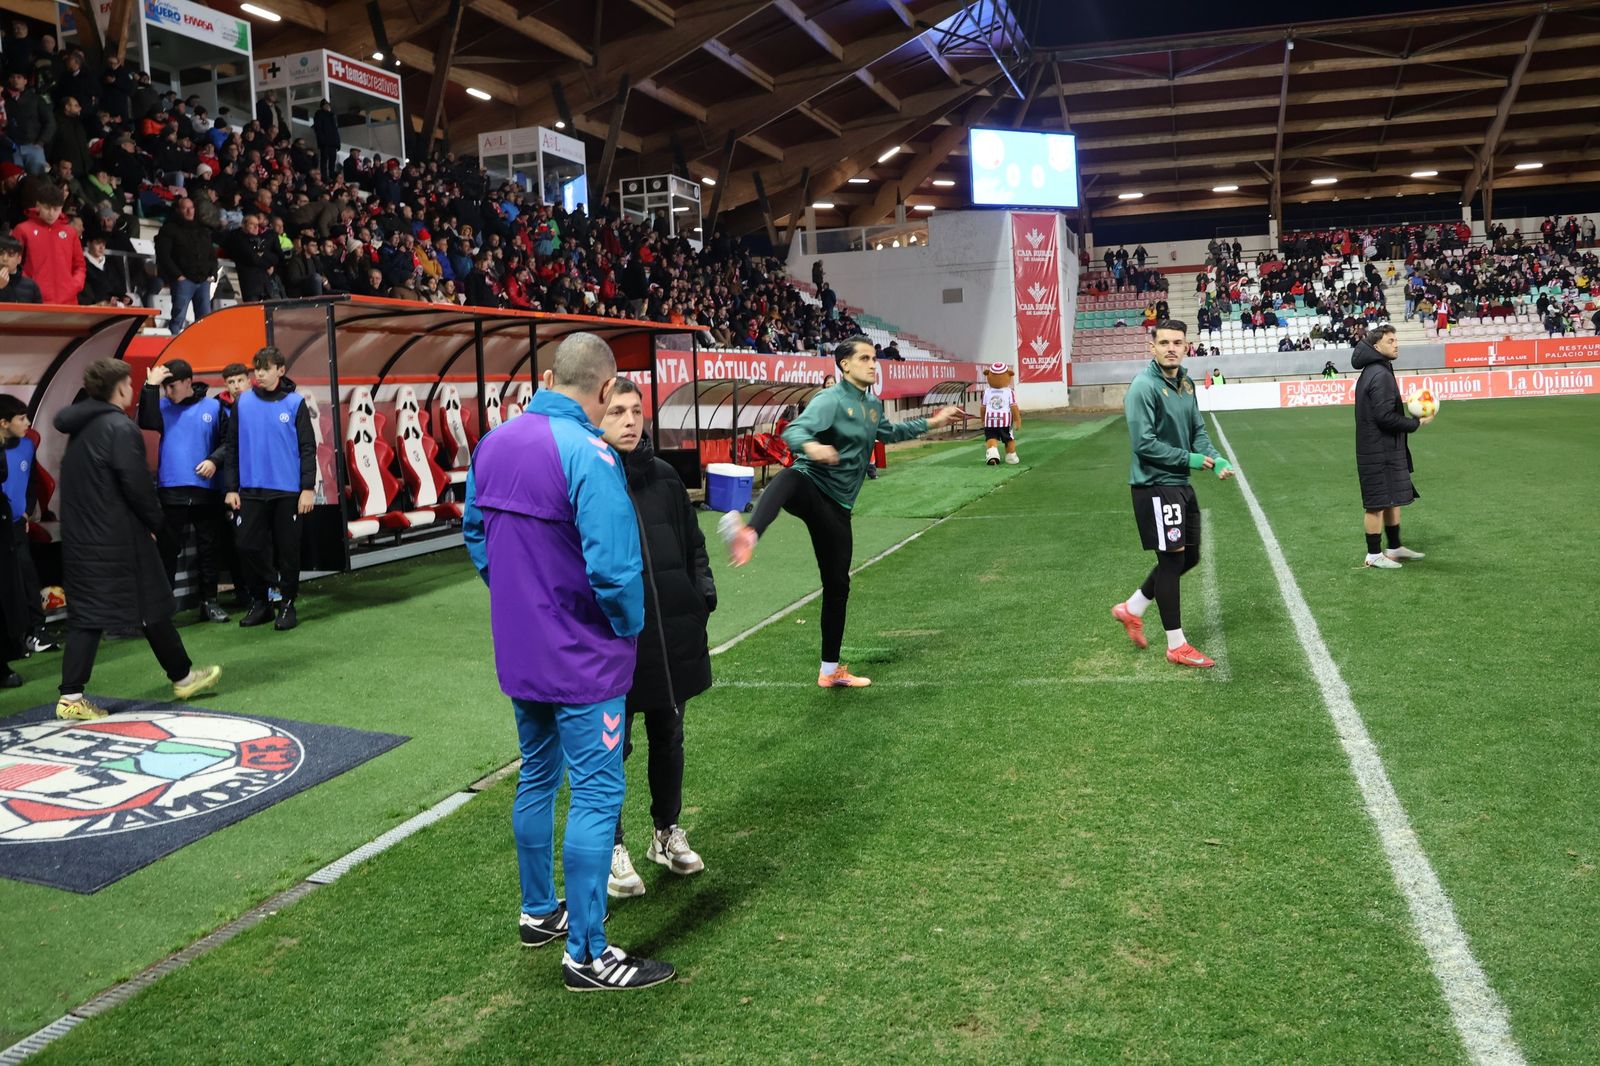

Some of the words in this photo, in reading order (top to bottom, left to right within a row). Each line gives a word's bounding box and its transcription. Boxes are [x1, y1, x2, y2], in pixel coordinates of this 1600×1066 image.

[1287, 382, 1345, 394] FUNDACIÓN
[1400, 377, 1416, 396] La
[1507, 370, 1527, 390] La
[1532, 370, 1593, 396] Opinión
[1163, 503, 1182, 525] 23
